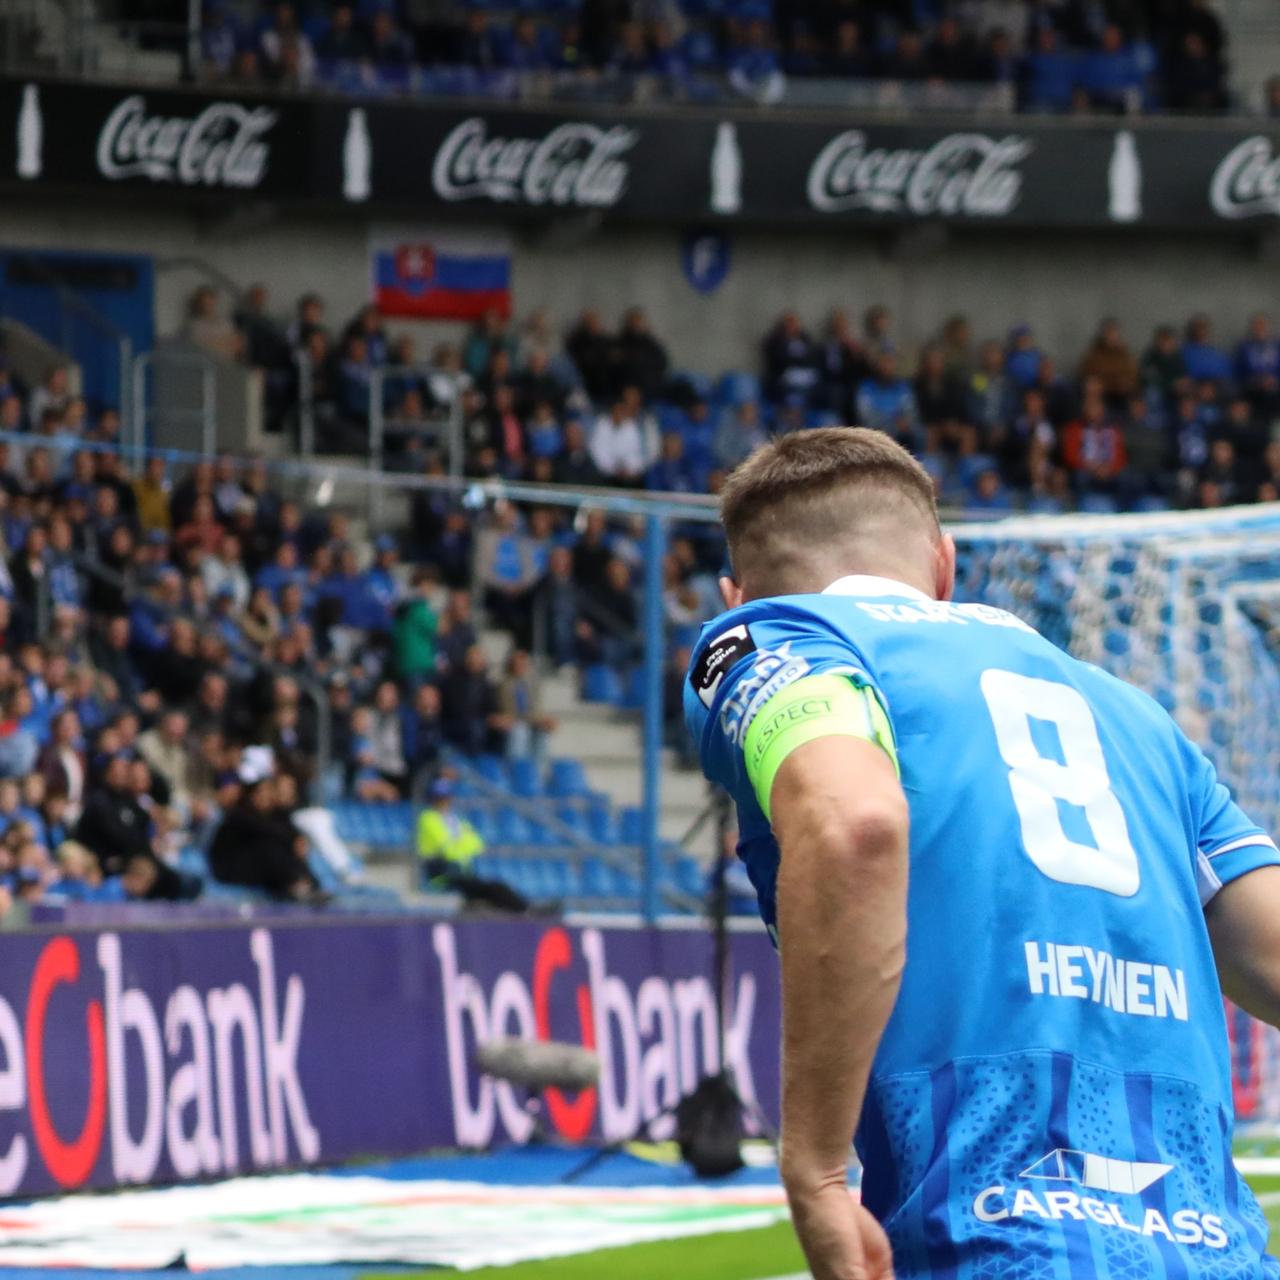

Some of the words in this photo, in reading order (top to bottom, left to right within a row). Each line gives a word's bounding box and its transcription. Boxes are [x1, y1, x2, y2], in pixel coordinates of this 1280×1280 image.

[752, 698, 834, 768] RESPECT
[980, 669, 1140, 897] 8
[1025, 941, 1189, 1021] HEYNEN
[972, 1185, 1229, 1250] CARGLASS
